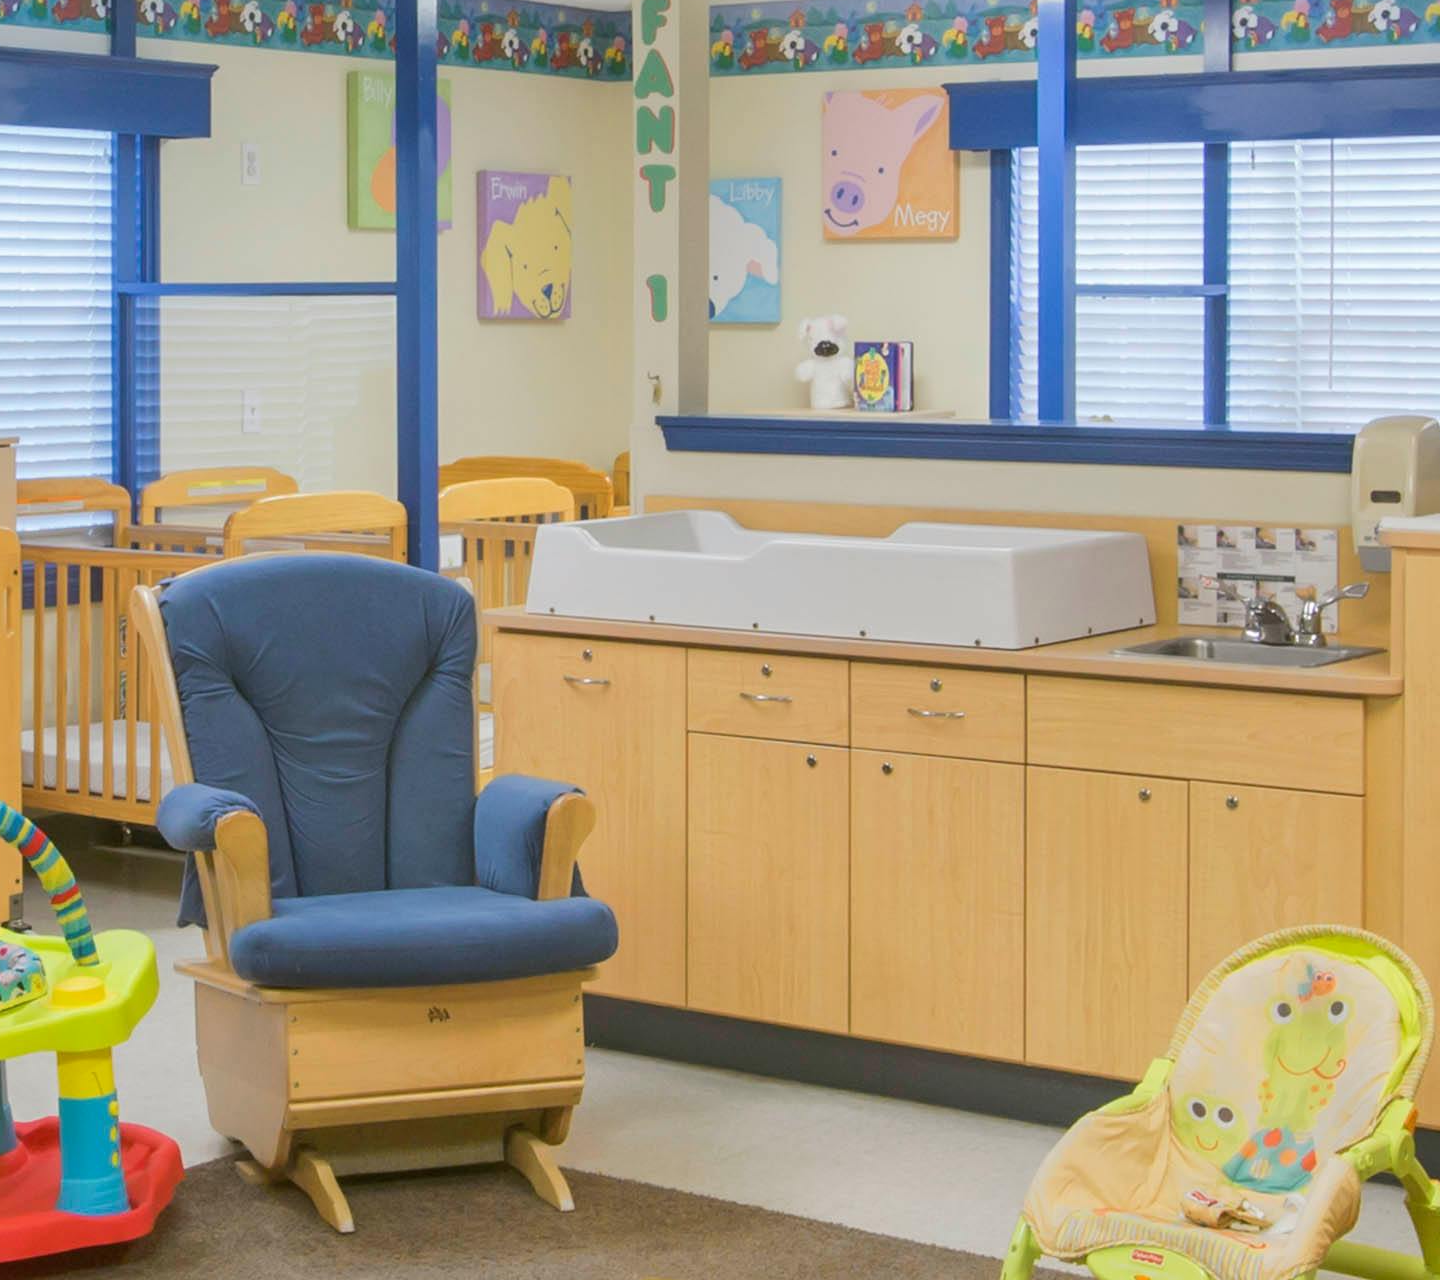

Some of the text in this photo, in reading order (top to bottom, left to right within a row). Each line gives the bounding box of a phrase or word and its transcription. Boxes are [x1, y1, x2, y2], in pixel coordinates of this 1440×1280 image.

[363, 76, 393, 108] Billy
[490, 176, 528, 201] Erwin
[729, 182, 776, 206] Libby
[893, 203, 951, 232] Megy
[646, 273, 668, 322] 1
